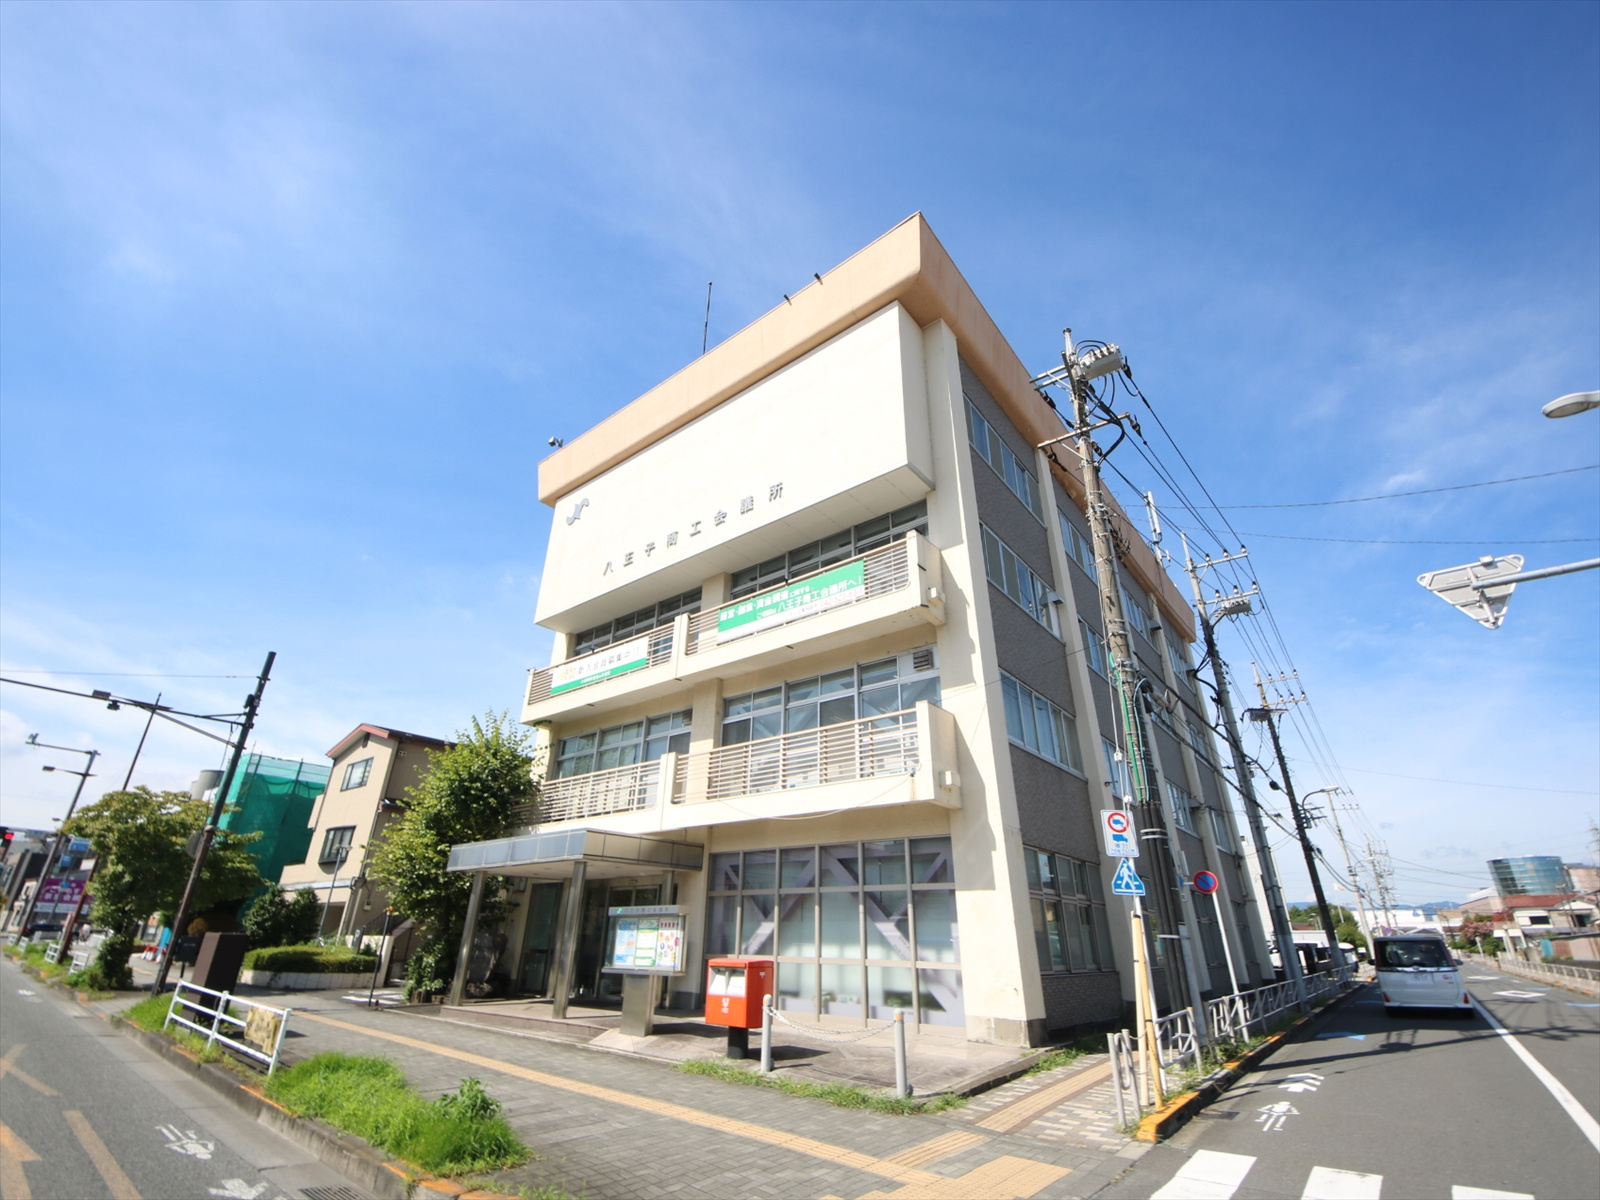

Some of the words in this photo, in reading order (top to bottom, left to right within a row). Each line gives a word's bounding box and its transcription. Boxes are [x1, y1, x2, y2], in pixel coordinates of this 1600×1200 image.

[603, 482, 783, 576] 八王子商工会議所
